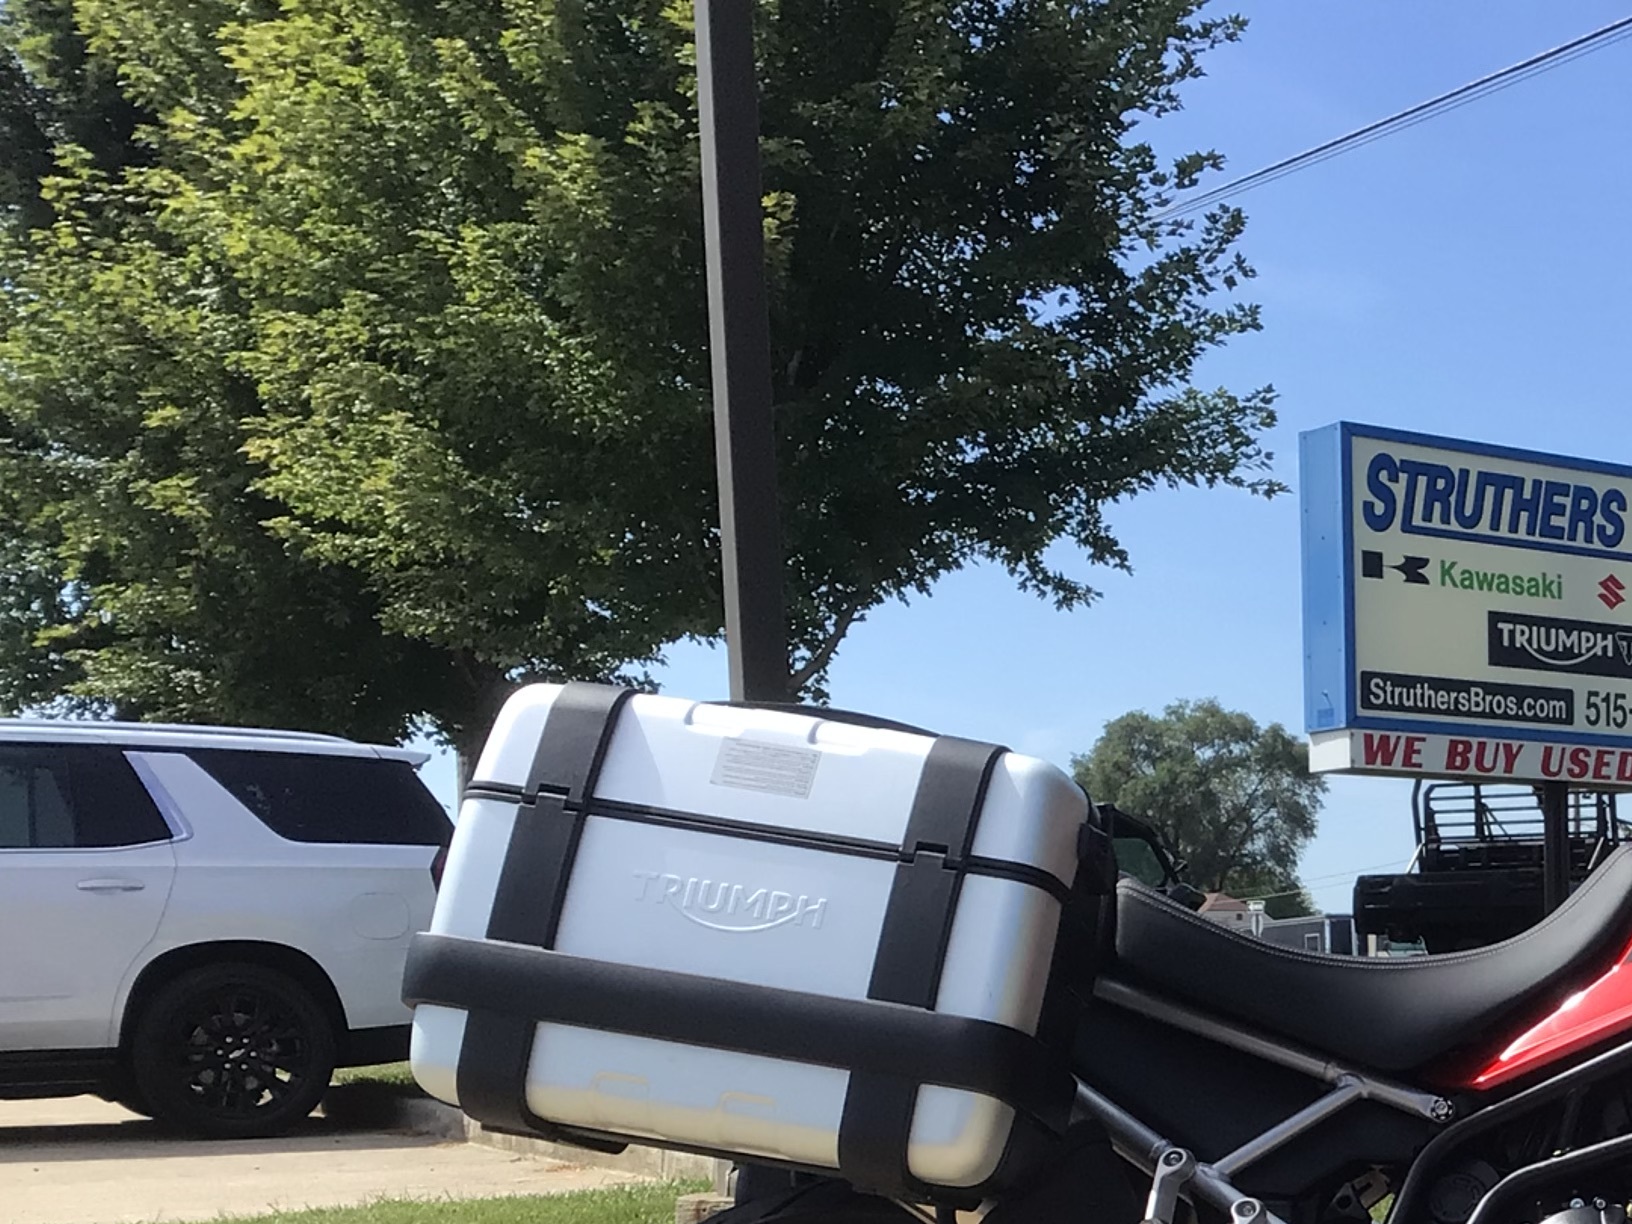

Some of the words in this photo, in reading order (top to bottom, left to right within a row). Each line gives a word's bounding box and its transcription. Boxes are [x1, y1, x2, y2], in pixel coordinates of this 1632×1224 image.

[1362, 453, 1627, 549] STRUTHERS
[1440, 560, 1562, 600] Kawasaki
[1497, 622, 1614, 665] TRIUMPH
[1369, 678, 1567, 720] StruthersBros.com
[1363, 733, 1426, 768] WE
[1445, 739, 1524, 775] BUY
[632, 869, 828, 932] TRIUMPH
